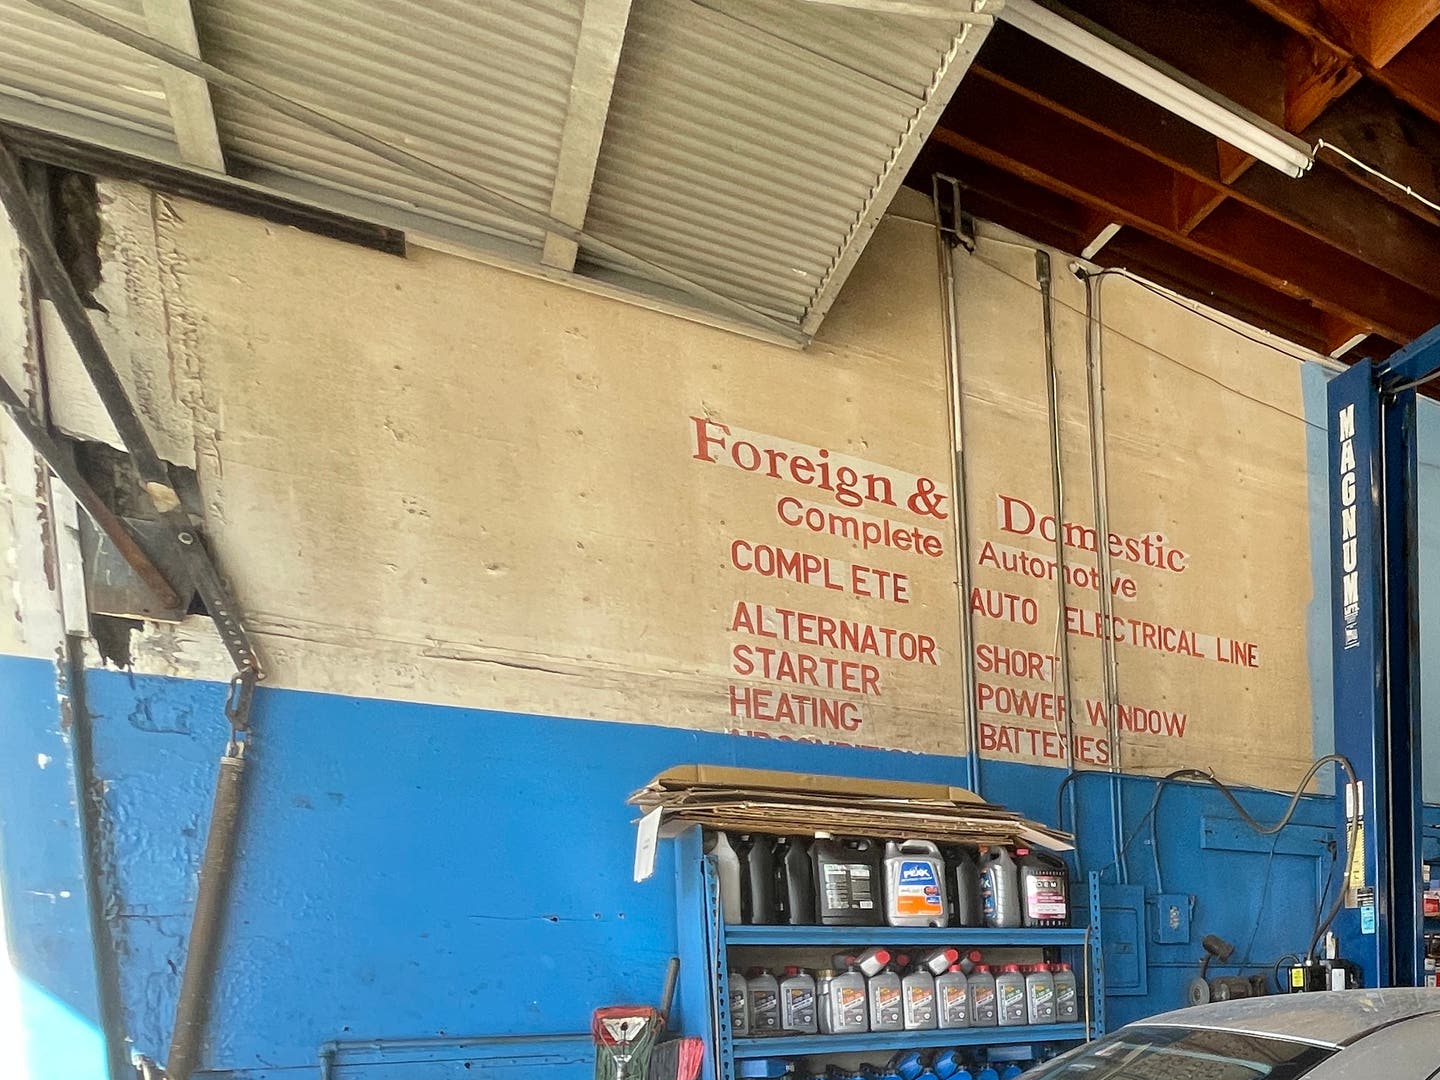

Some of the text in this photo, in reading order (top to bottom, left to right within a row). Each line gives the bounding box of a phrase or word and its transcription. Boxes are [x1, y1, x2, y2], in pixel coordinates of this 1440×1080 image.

[689, 415, 1186, 573] Foreign & Domestic
[1339, 403, 1359, 609] MAGNUM
[777, 496, 1137, 598] Complete Automotve
[732, 601, 938, 665] ALTERNATOR
[970, 588, 1038, 625] AUTO
[1064, 606, 1205, 658] ELECTRICAL
[1217, 637, 1259, 668] LINE
[733, 644, 882, 696] STARTER
[976, 644, 1060, 682] SHORT
[729, 685, 863, 732] HEATING
[1085, 699, 1188, 738] WNDOW
